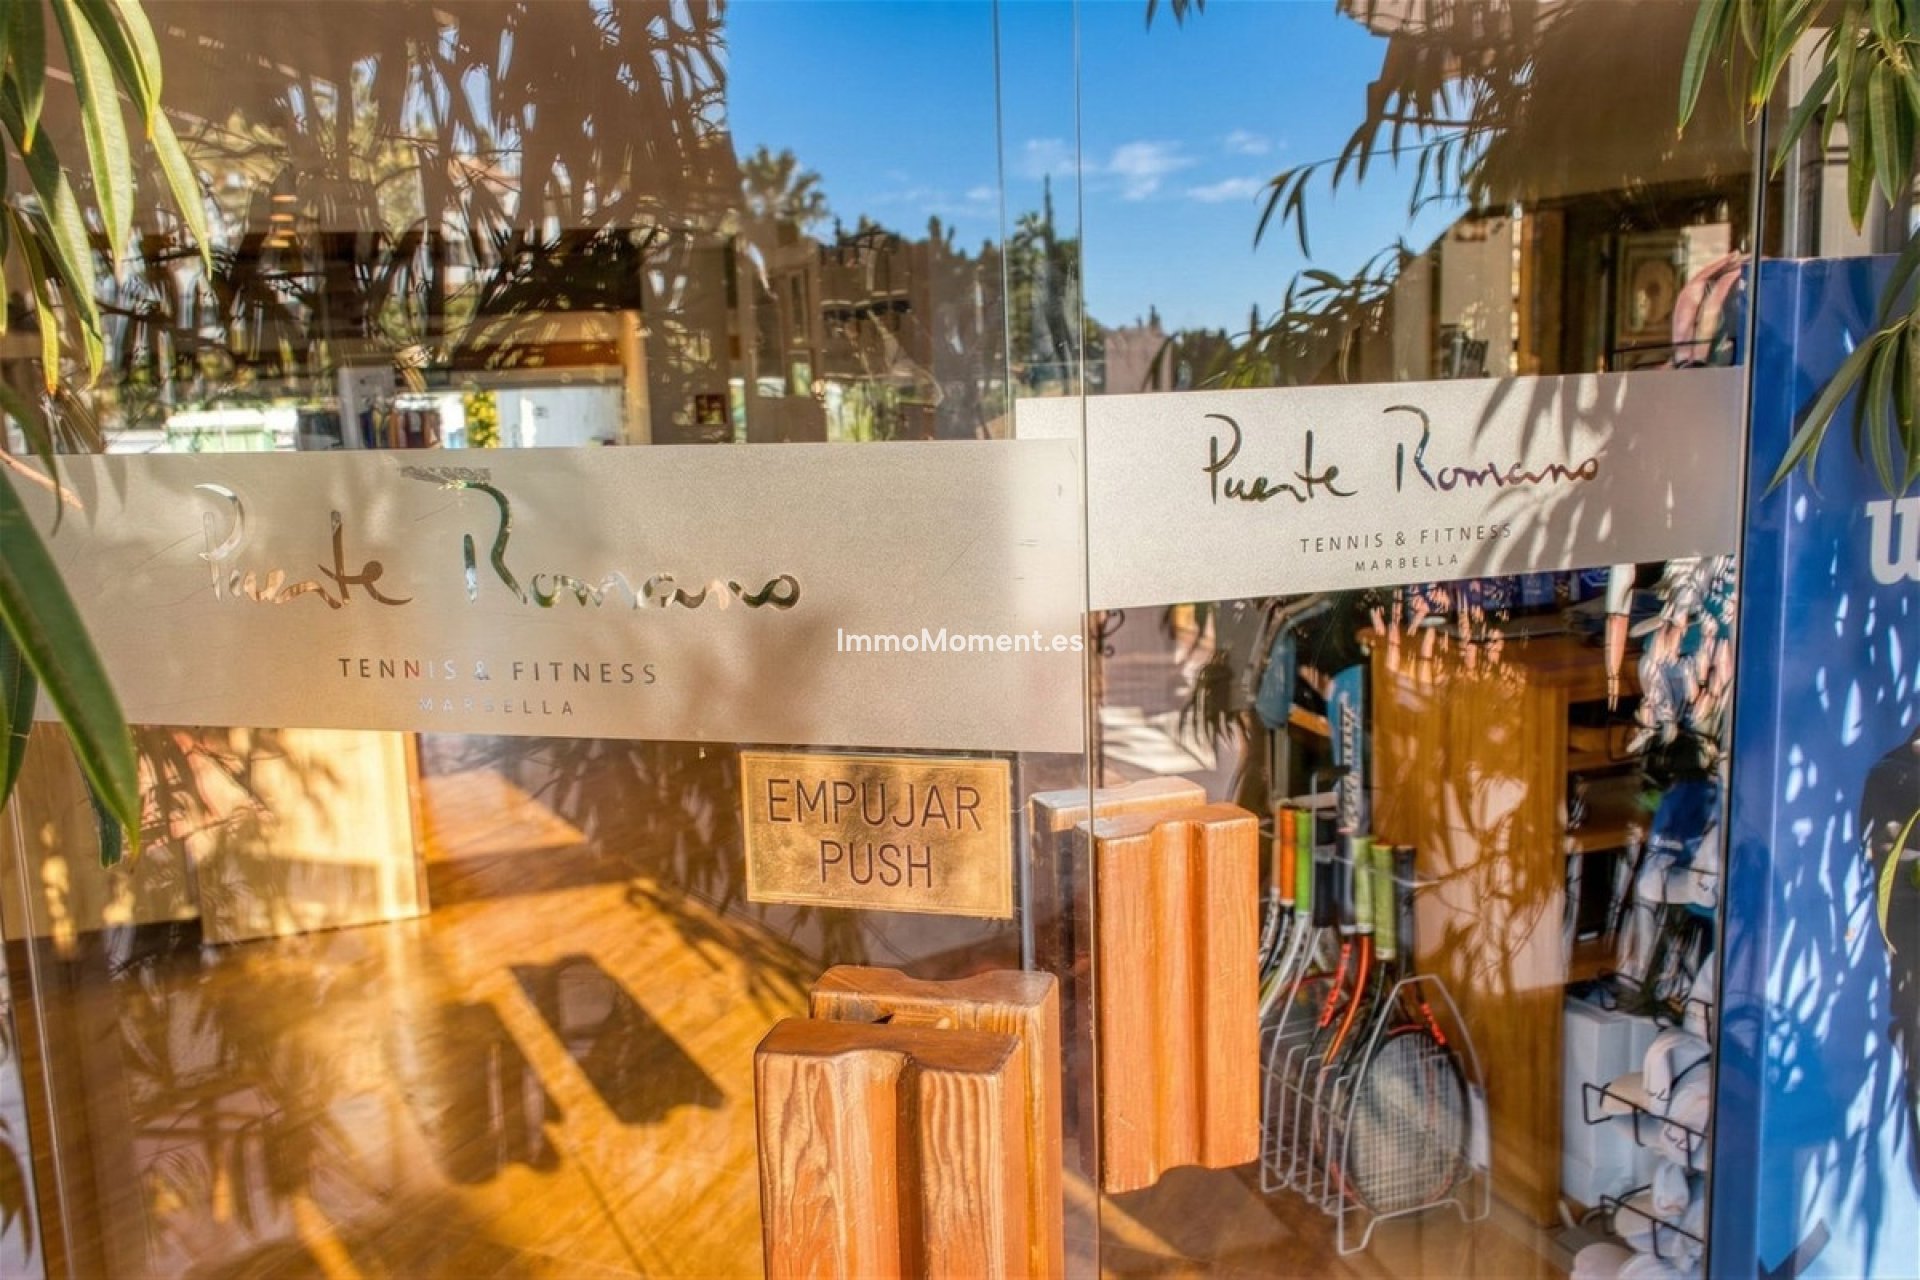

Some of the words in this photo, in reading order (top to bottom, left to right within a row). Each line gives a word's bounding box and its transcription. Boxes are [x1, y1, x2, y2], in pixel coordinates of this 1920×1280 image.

[1202, 412, 1358, 505] Puente
[1382, 404, 1600, 494] Romano
[194, 482, 414, 609] Puente
[398, 465, 801, 611] Romano
[1300, 532, 1384, 553] TENNIS
[1394, 530, 1406, 547] &
[1420, 522, 1512, 545] FITNESS
[1354, 553, 1459, 572] MARBELLA
[338, 657, 457, 680] TENNIS
[473, 659, 491, 681] &
[511, 660, 657, 684] FITNESS
[419, 697, 574, 716] MARBELLA
[766, 778, 983, 832] EMPUJAR
[819, 839, 932, 889] PUSH
